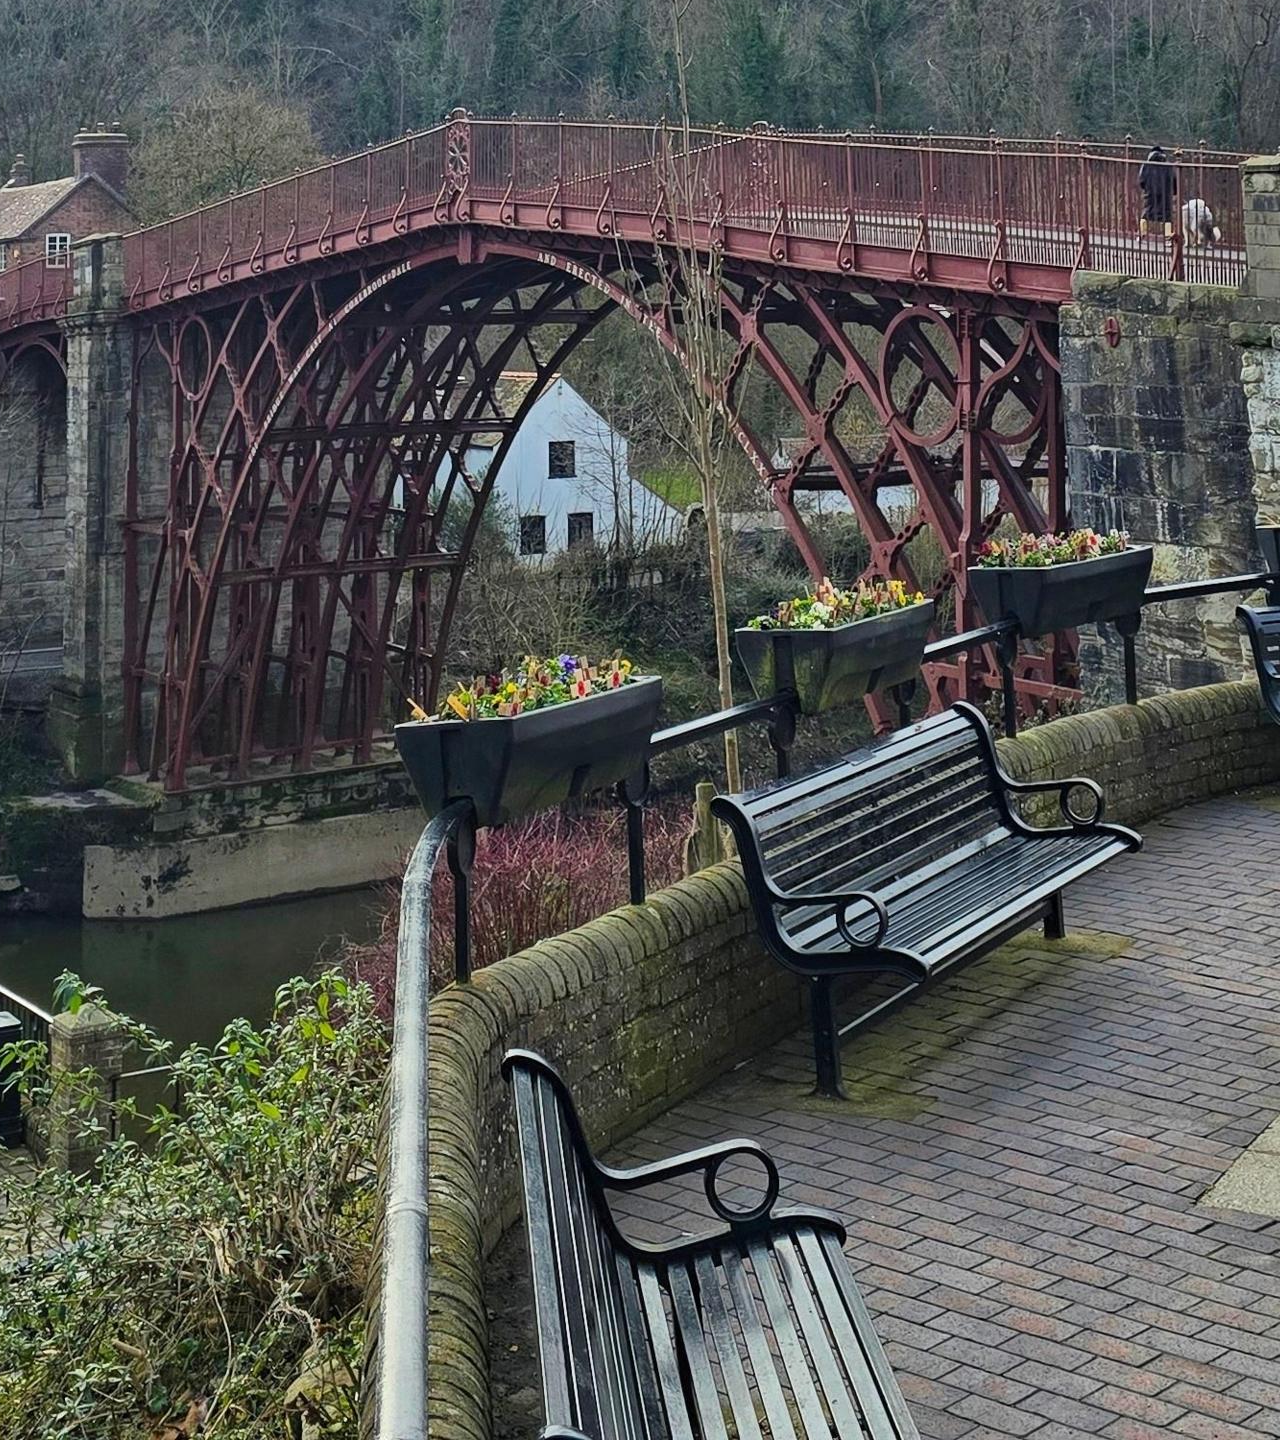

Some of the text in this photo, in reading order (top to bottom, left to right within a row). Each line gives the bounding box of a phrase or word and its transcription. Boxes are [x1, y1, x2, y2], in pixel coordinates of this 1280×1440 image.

[305, 334, 322, 359] CAST
[537, 252, 558, 267] AND
[565, 261, 611, 295] ERECTED
